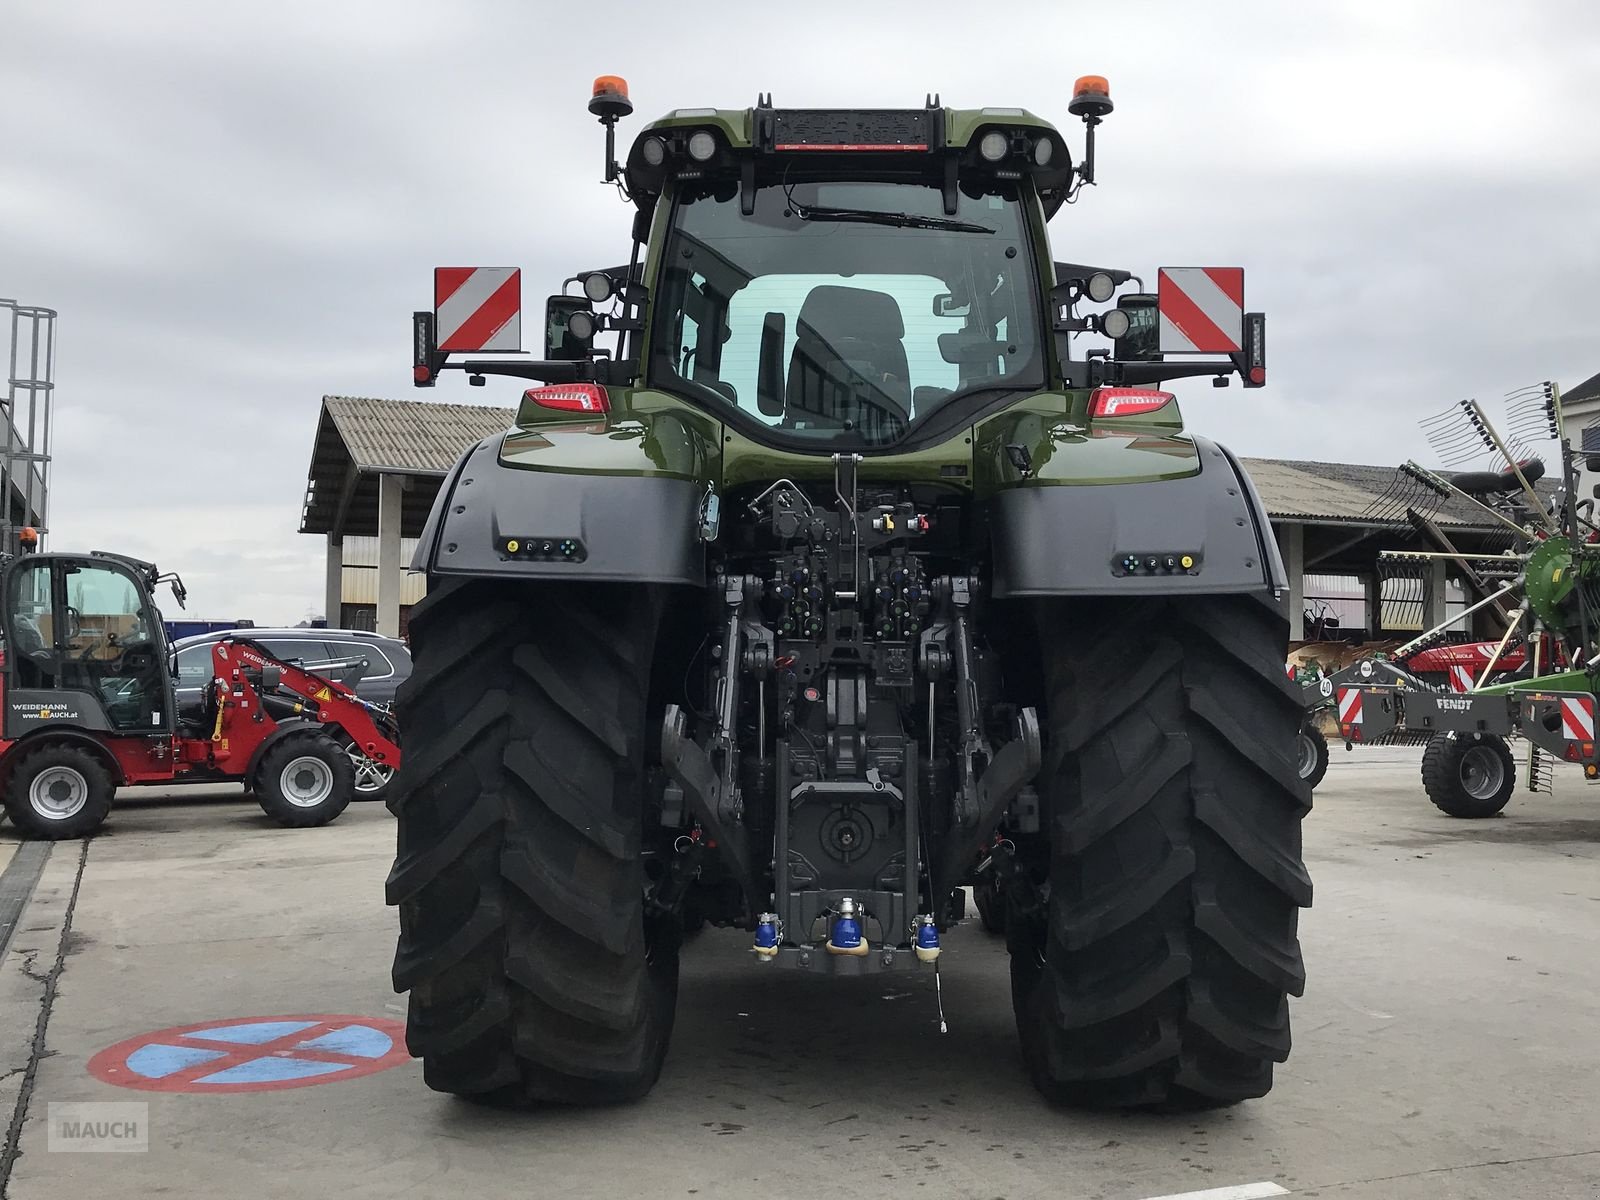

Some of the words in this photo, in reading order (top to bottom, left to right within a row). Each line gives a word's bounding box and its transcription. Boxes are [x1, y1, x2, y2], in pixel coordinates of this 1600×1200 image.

[1322, 681, 1331, 694] 40
[12, 703, 68, 711] WEIDEMANN
[1436, 699, 1473, 710] FENDT
[22, 710, 78, 719] www.MAUCH.at
